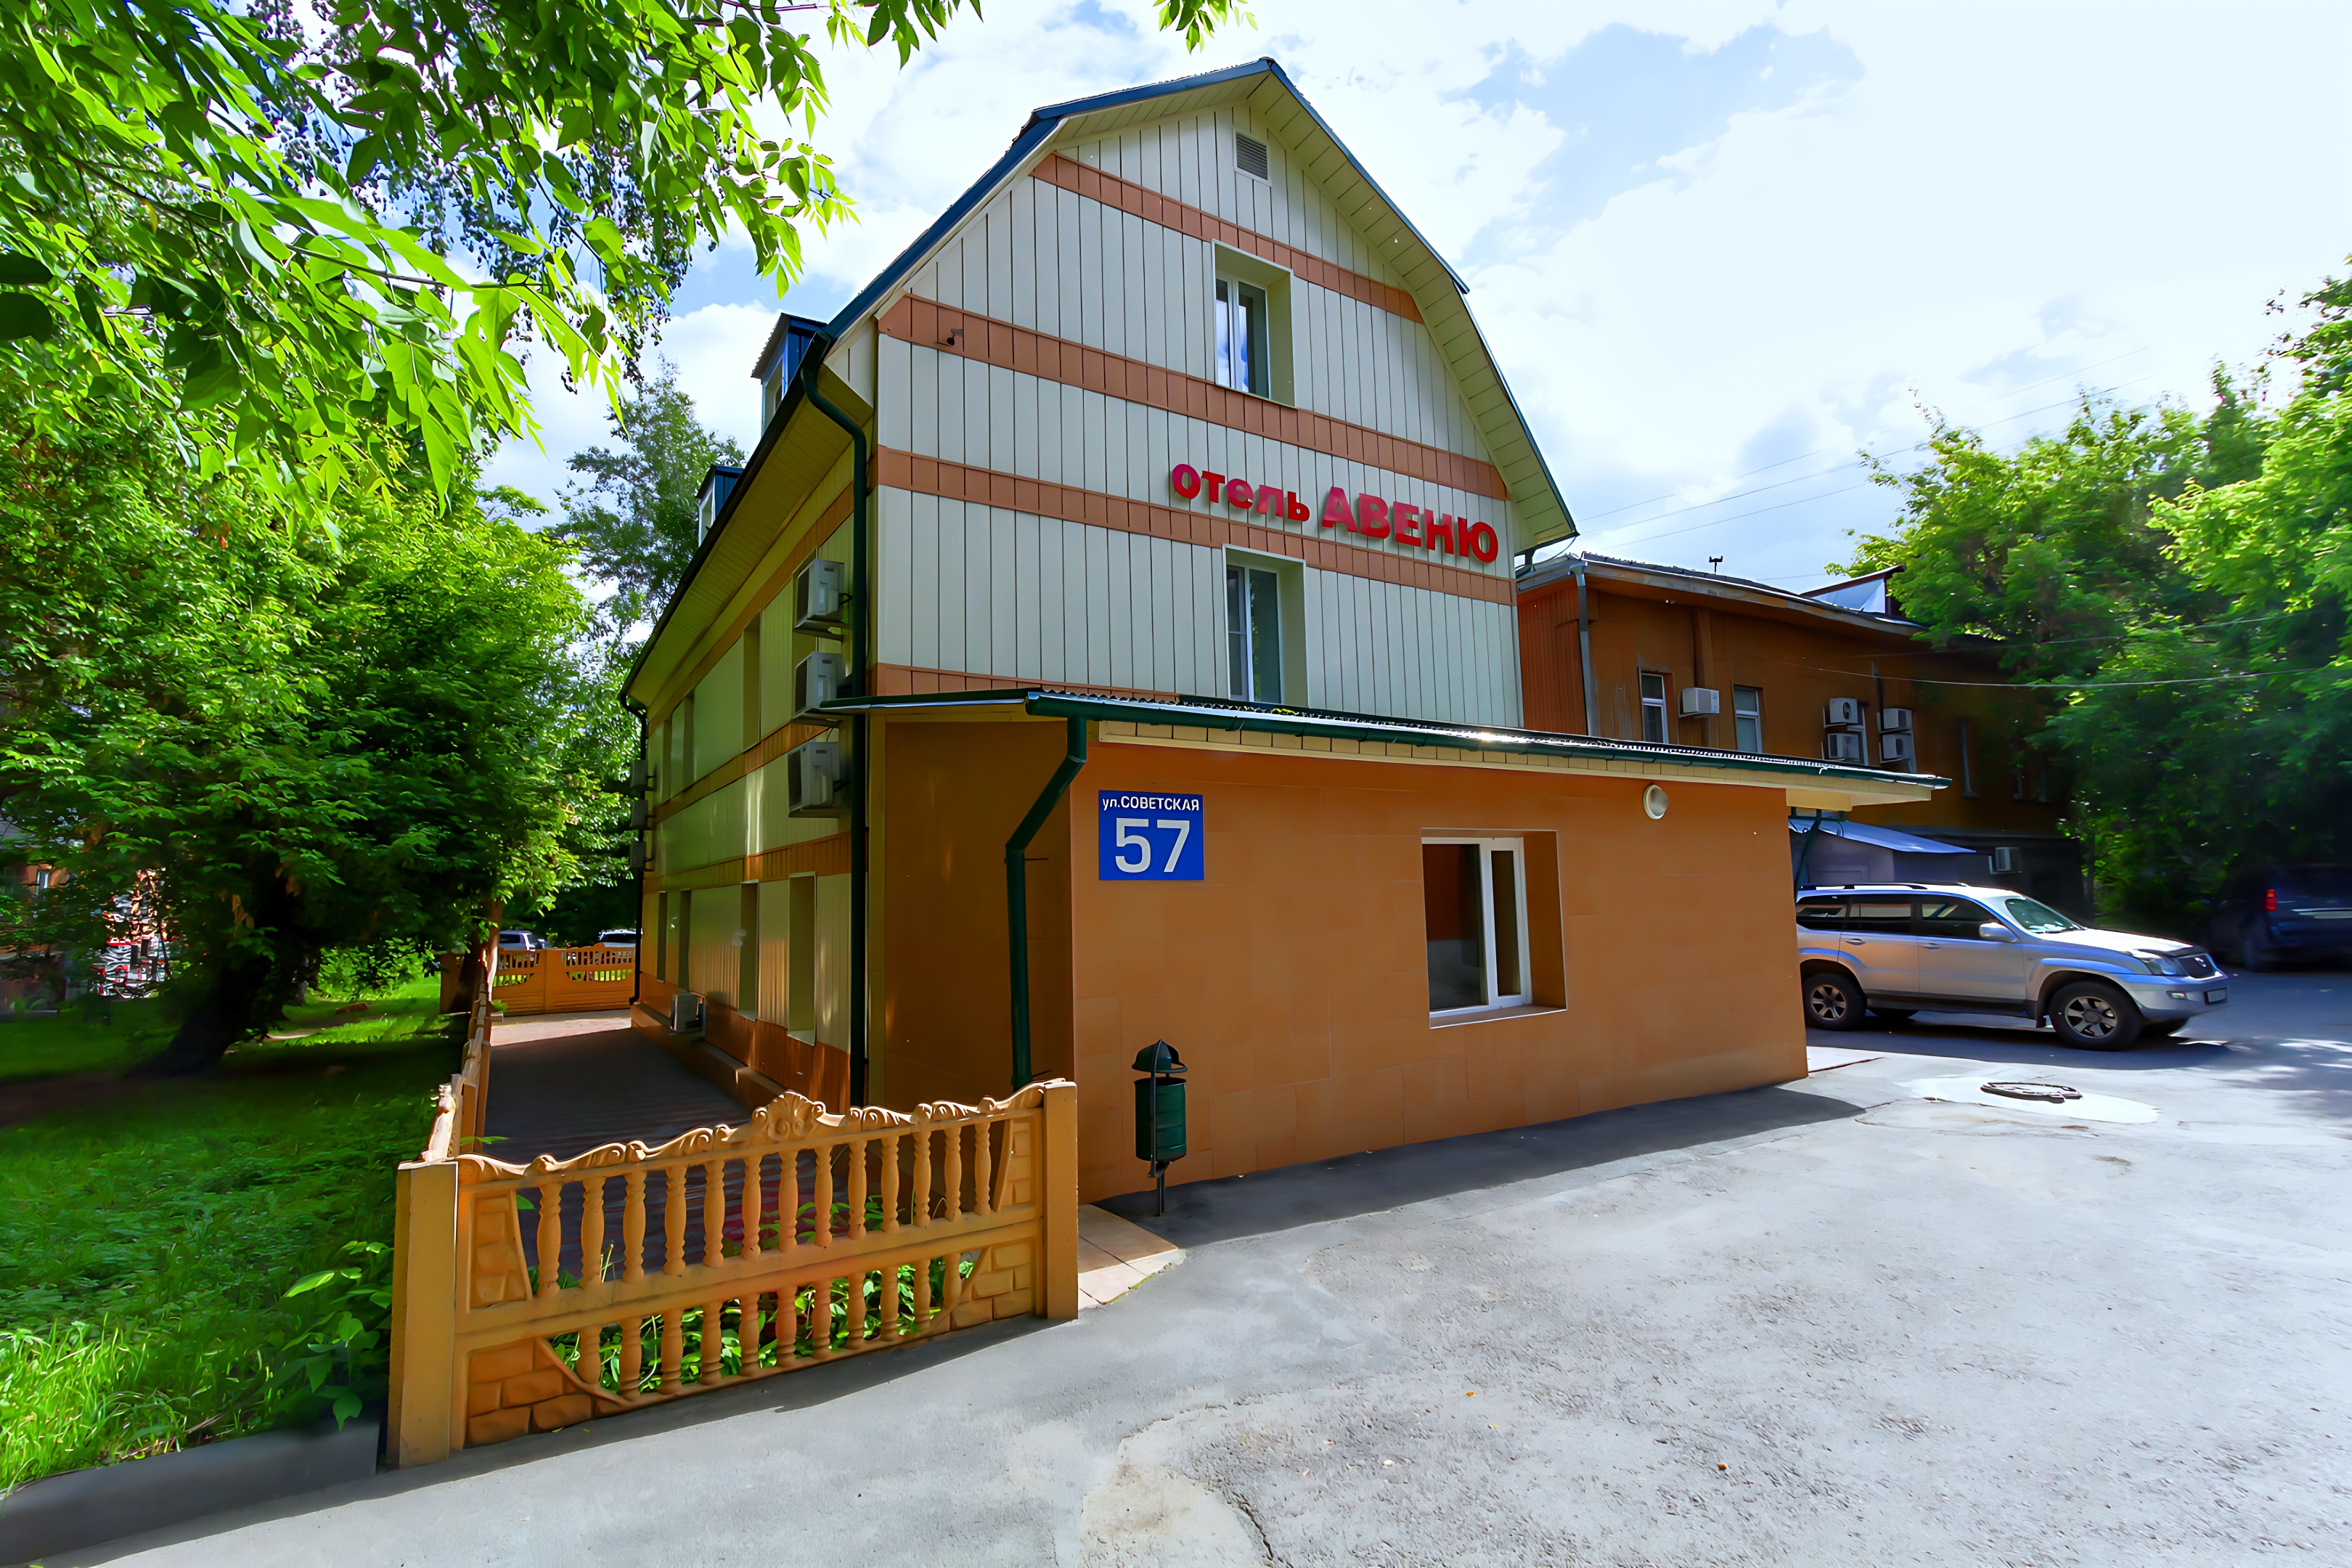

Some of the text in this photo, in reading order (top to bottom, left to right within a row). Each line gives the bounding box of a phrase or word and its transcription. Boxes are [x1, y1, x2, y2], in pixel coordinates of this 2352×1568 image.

[1171, 463, 1499, 563] отель АВЕНЮ
[1115, 817, 1190, 873] 57
